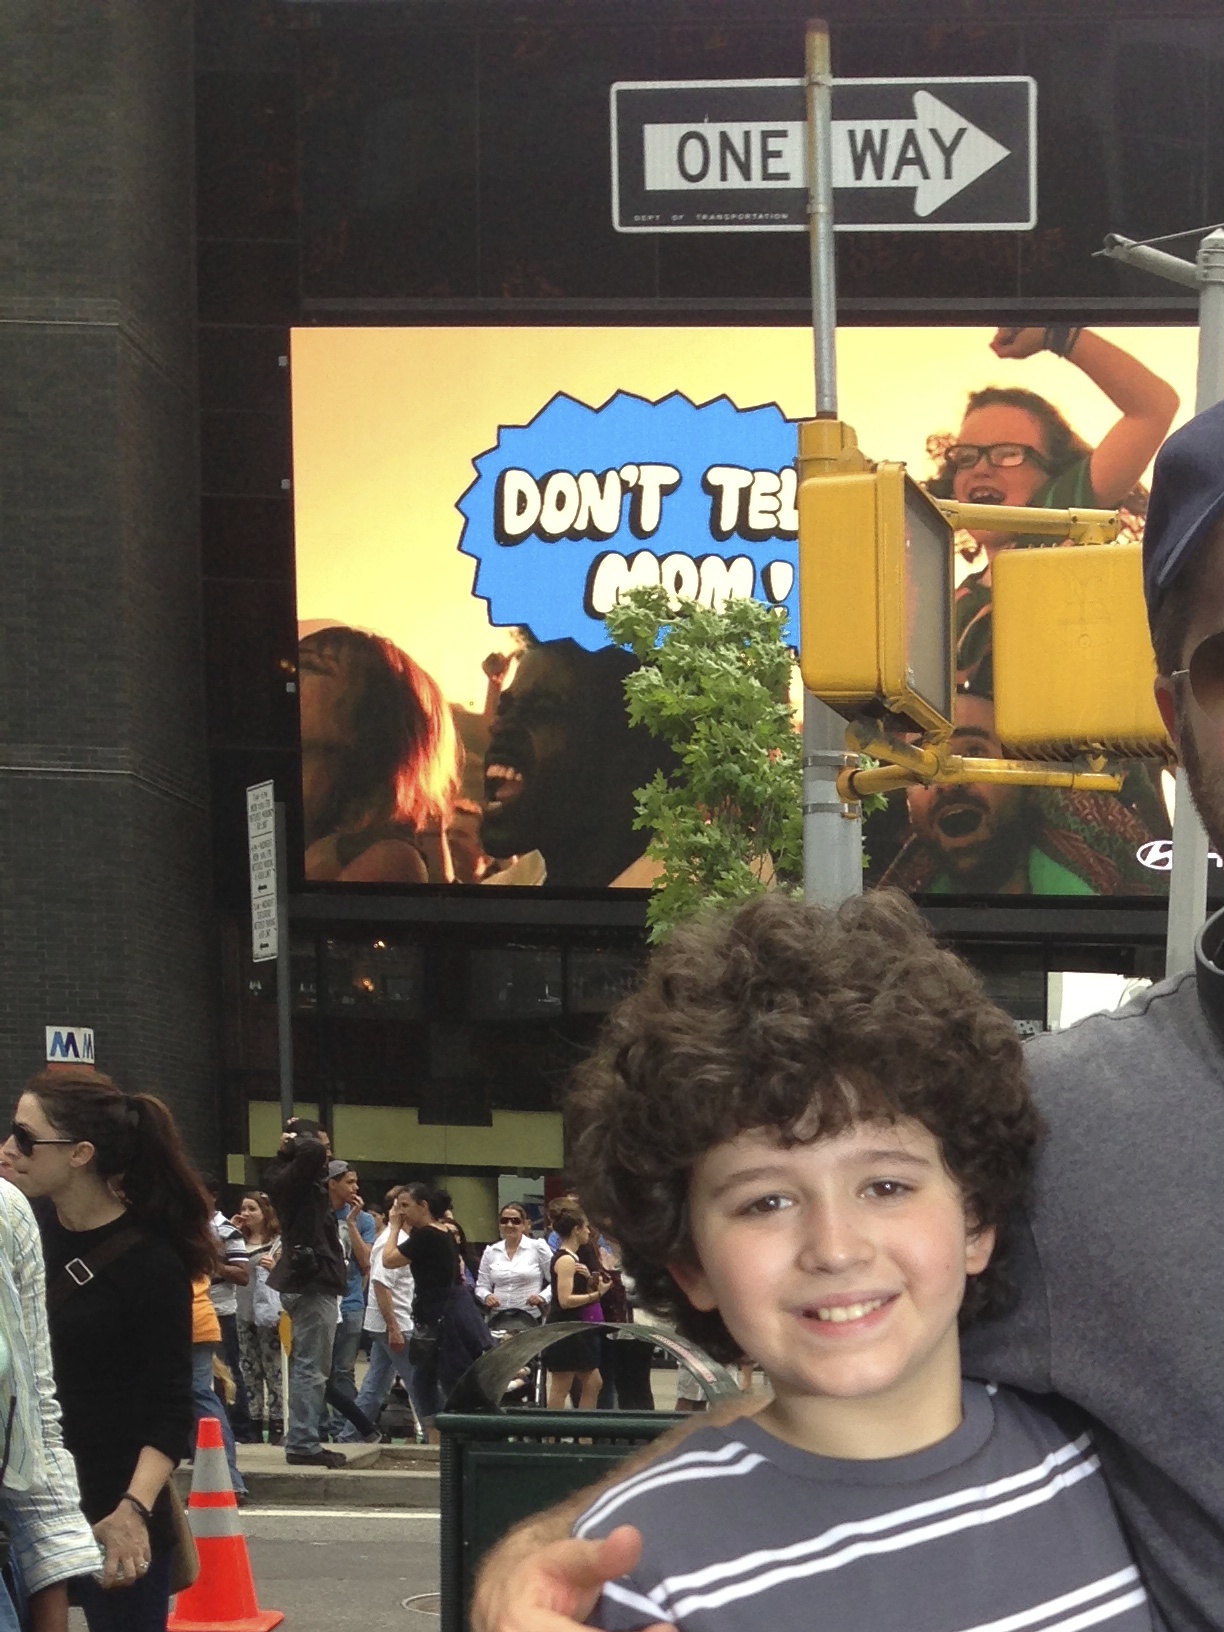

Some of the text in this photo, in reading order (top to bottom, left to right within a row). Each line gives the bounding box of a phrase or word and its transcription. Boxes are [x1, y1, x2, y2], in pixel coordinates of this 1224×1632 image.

[676, 127, 968, 183] ONE WAY
[696, 212, 789, 221] TRANSPORTATION
[494, 462, 682, 547] DON'T
